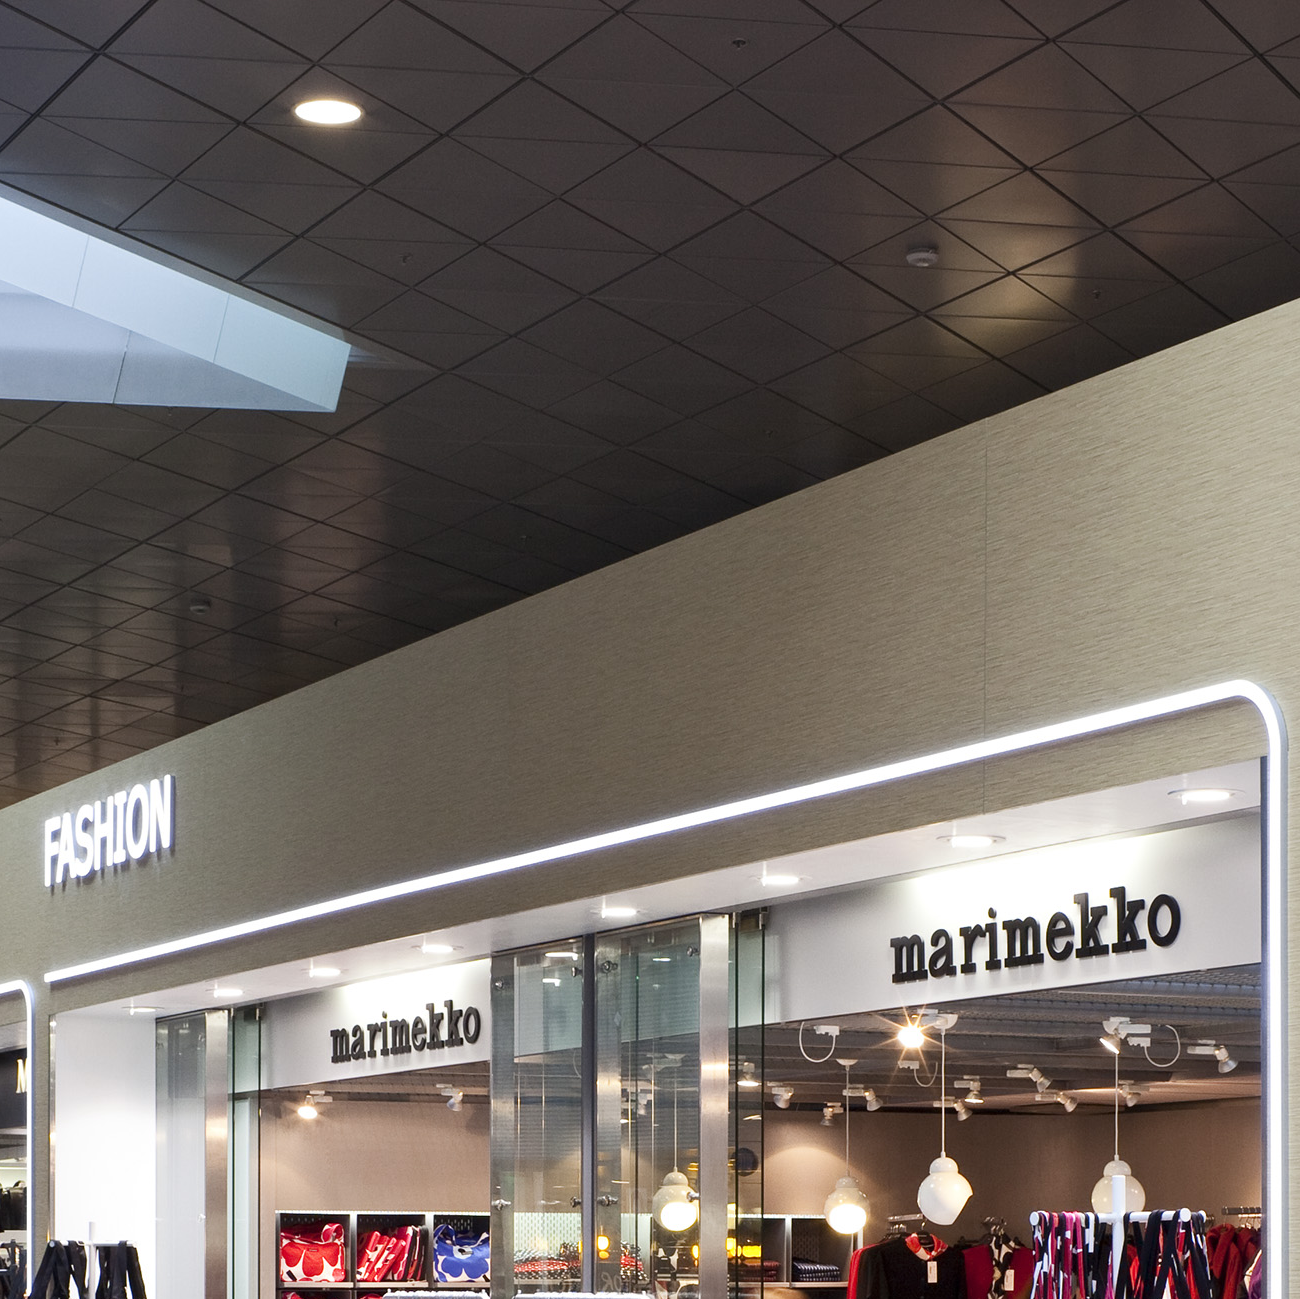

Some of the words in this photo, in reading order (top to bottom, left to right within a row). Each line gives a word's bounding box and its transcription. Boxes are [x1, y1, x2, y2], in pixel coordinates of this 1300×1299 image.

[44, 774, 176, 887] FASHION
[890, 886, 1181, 984] marimekko
[330, 999, 483, 1063] marimekko
